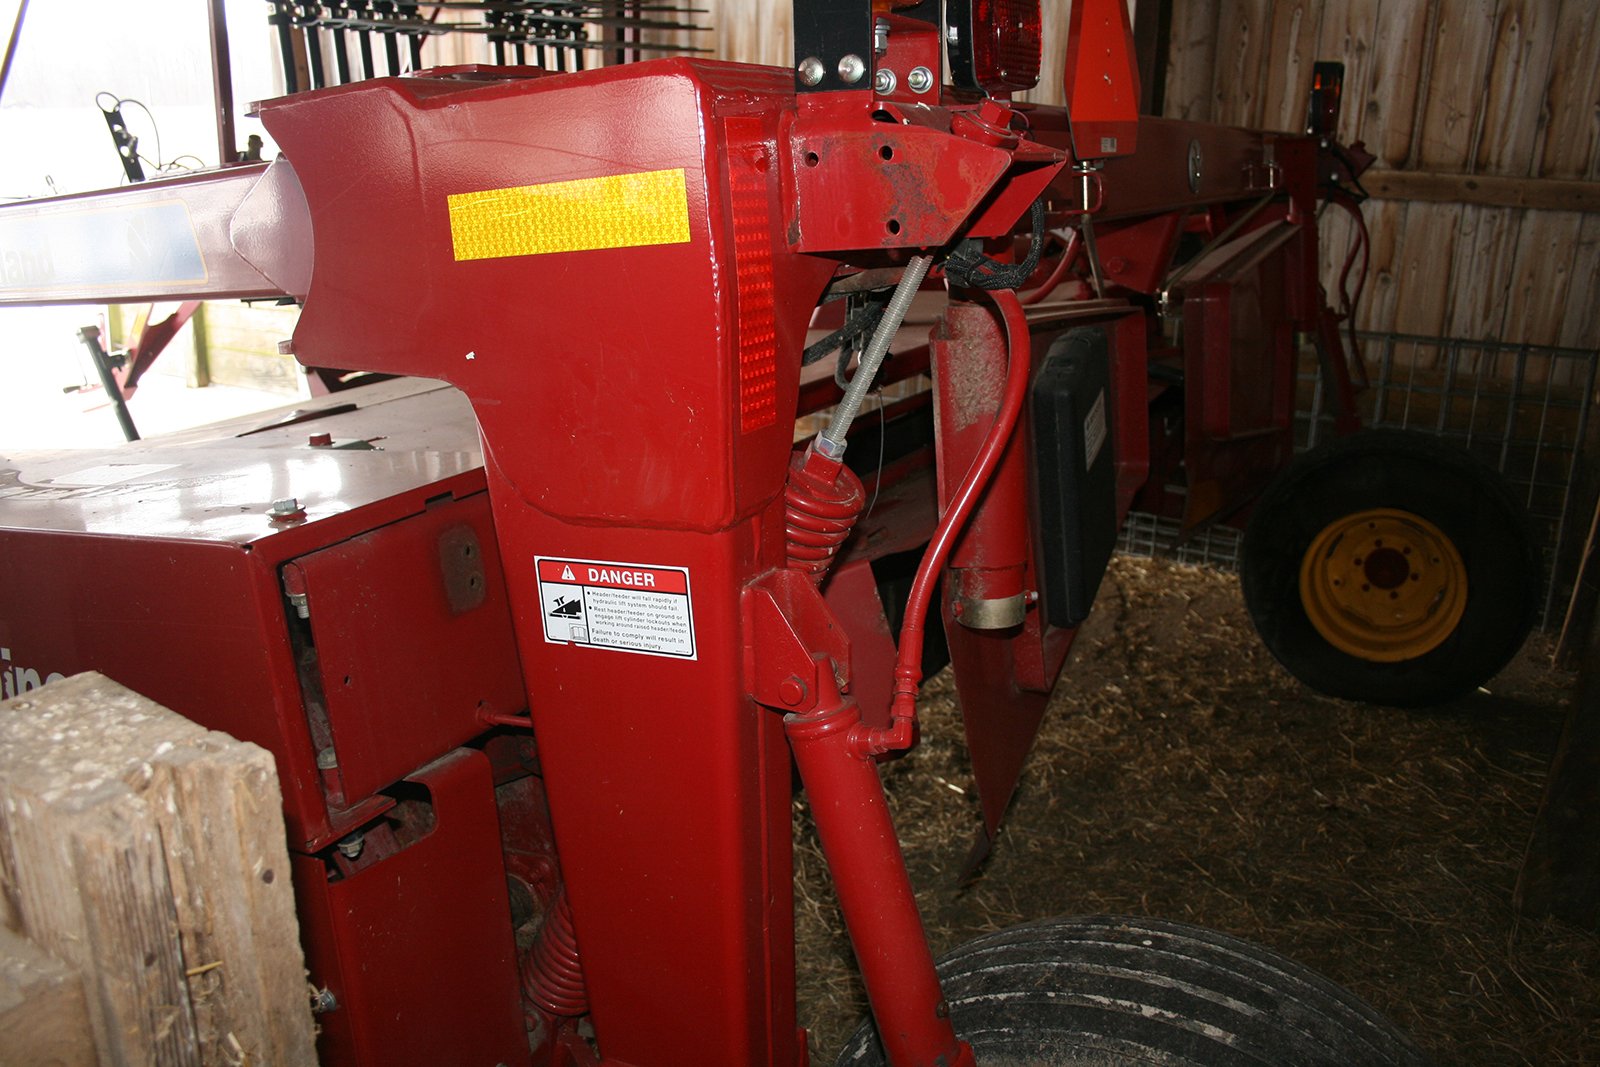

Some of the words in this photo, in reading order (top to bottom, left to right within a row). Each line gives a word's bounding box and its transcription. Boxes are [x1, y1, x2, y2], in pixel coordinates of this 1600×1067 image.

[588, 568, 655, 587] DANGER
[592, 591, 630, 600] Header/feeder
[593, 598, 617, 606] hydraulic
[607, 608, 645, 617] header/feeder
[655, 613, 675, 621] ground
[596, 620, 615, 628] working
[646, 619, 671, 627] lockouts
[591, 628, 612, 636] Failure
[622, 632, 644, 641] comply
[644, 642, 663, 650] injury.
[0, 647, 66, 700] in
